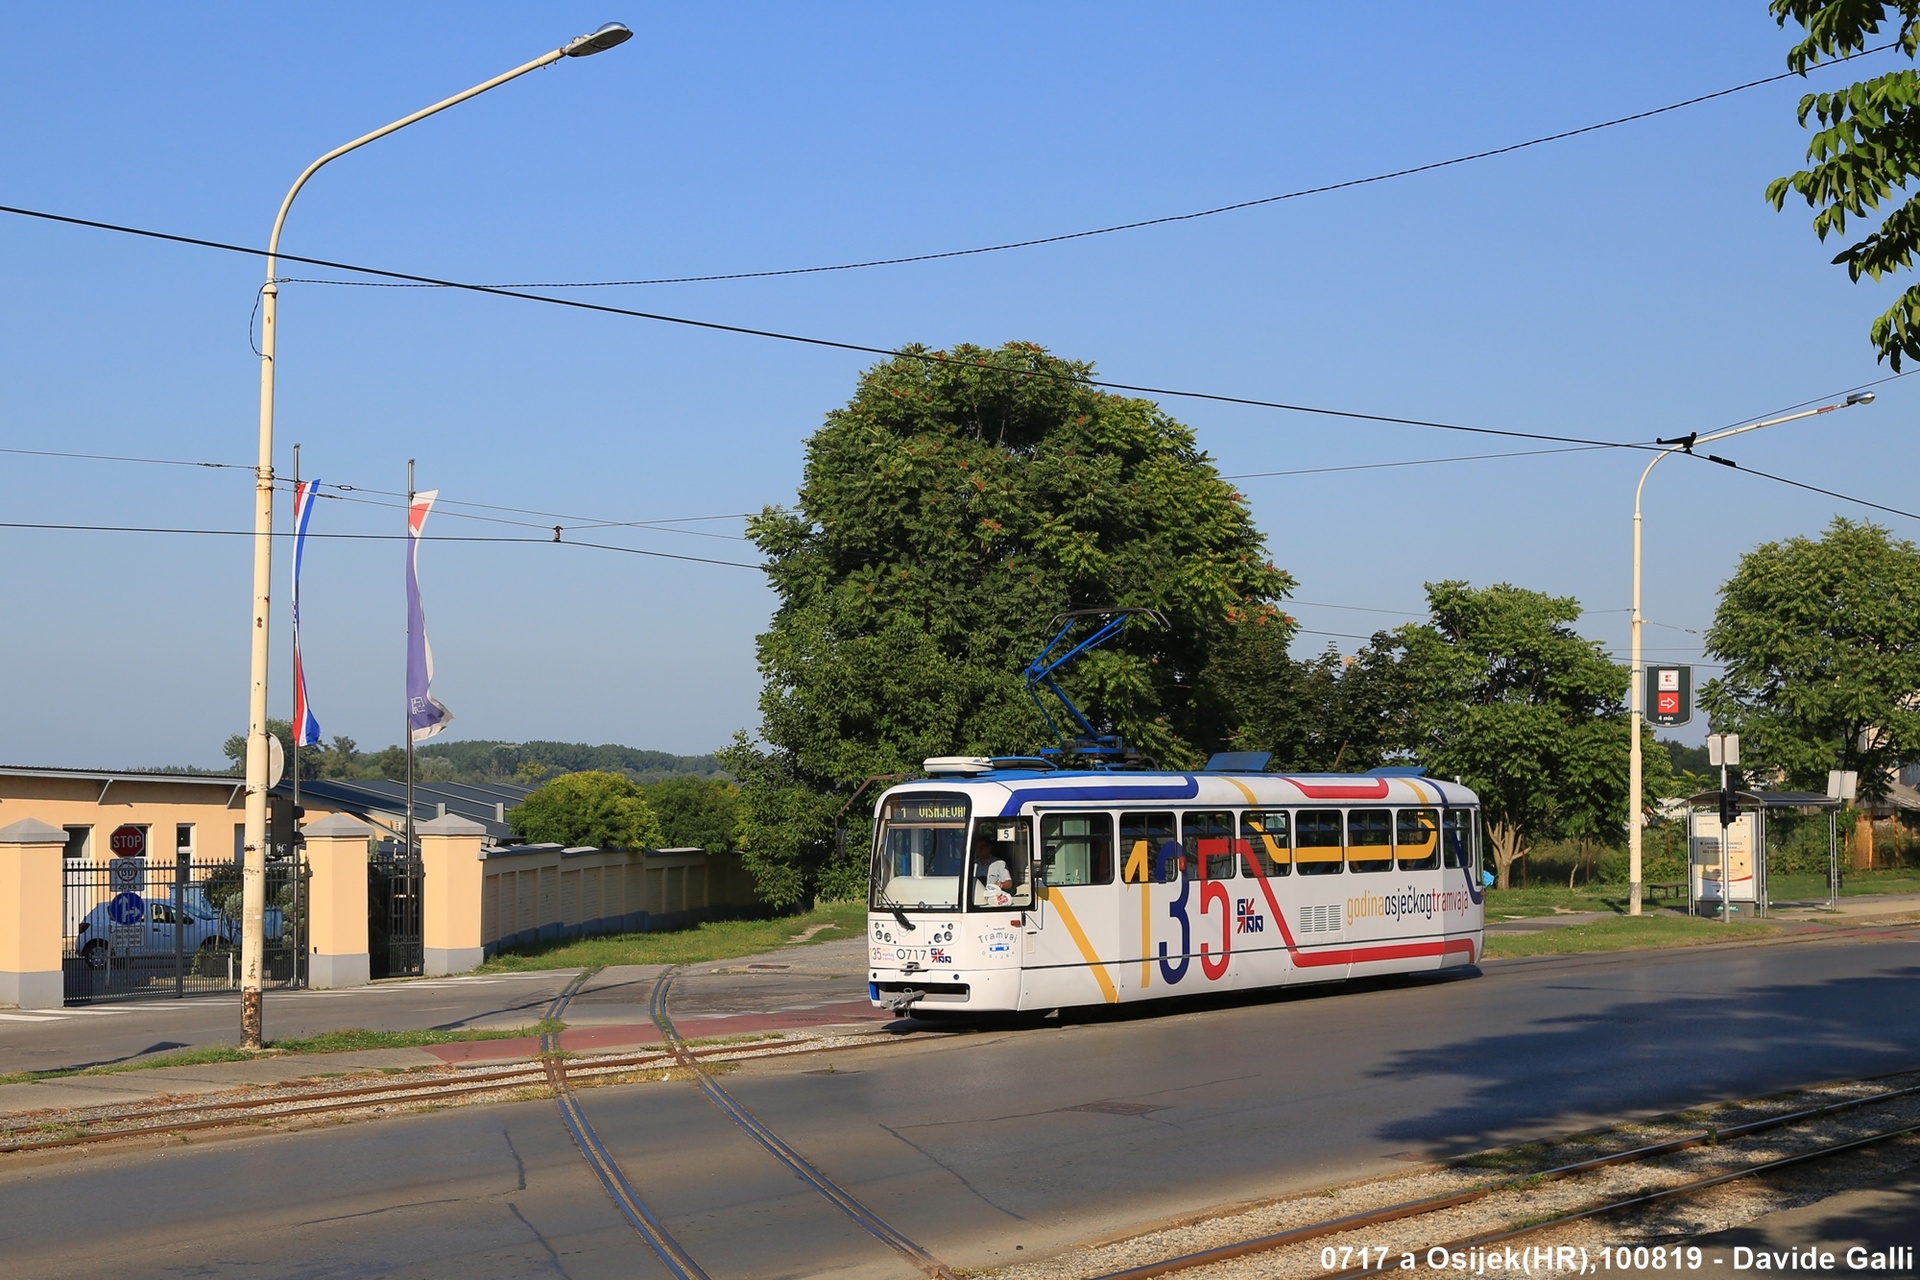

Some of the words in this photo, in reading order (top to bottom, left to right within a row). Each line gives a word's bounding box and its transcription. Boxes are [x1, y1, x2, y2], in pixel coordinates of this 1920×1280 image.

[901, 807, 906, 818] 1
[1003, 829, 1010, 839] 5
[113, 835, 142, 848] STOP
[977, 931, 1018, 943] Tramvaj
[896, 948, 927, 960] 0717
